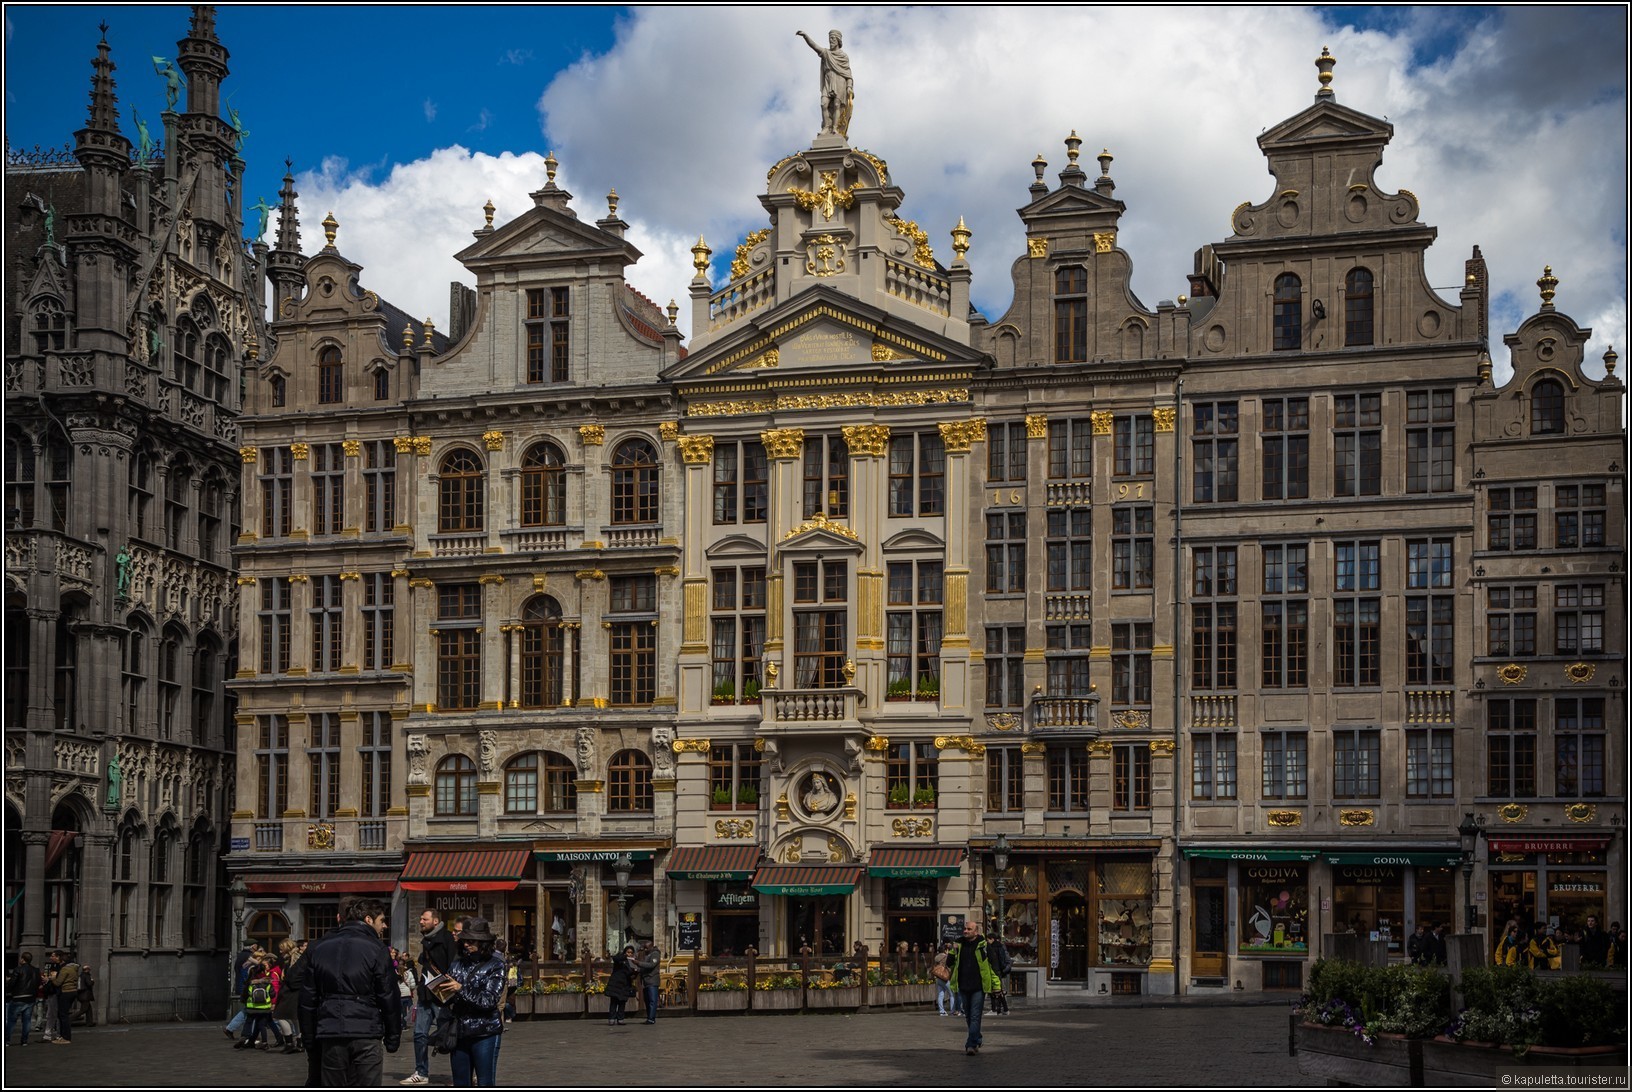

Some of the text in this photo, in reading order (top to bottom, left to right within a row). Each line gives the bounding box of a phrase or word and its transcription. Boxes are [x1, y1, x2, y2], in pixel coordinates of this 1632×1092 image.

[1118, 484, 1144, 499] 97
[993, 489, 1021, 505] 16
[557, 852, 632, 861] MAISON ANTOIE
[1248, 868, 1299, 878] GODIVA
[1342, 868, 1394, 878] GODIVA
[1553, 884, 1600, 892] BRUYERRE
[436, 893, 477, 910] neuhaus
[718, 894, 755, 905] Affligem
